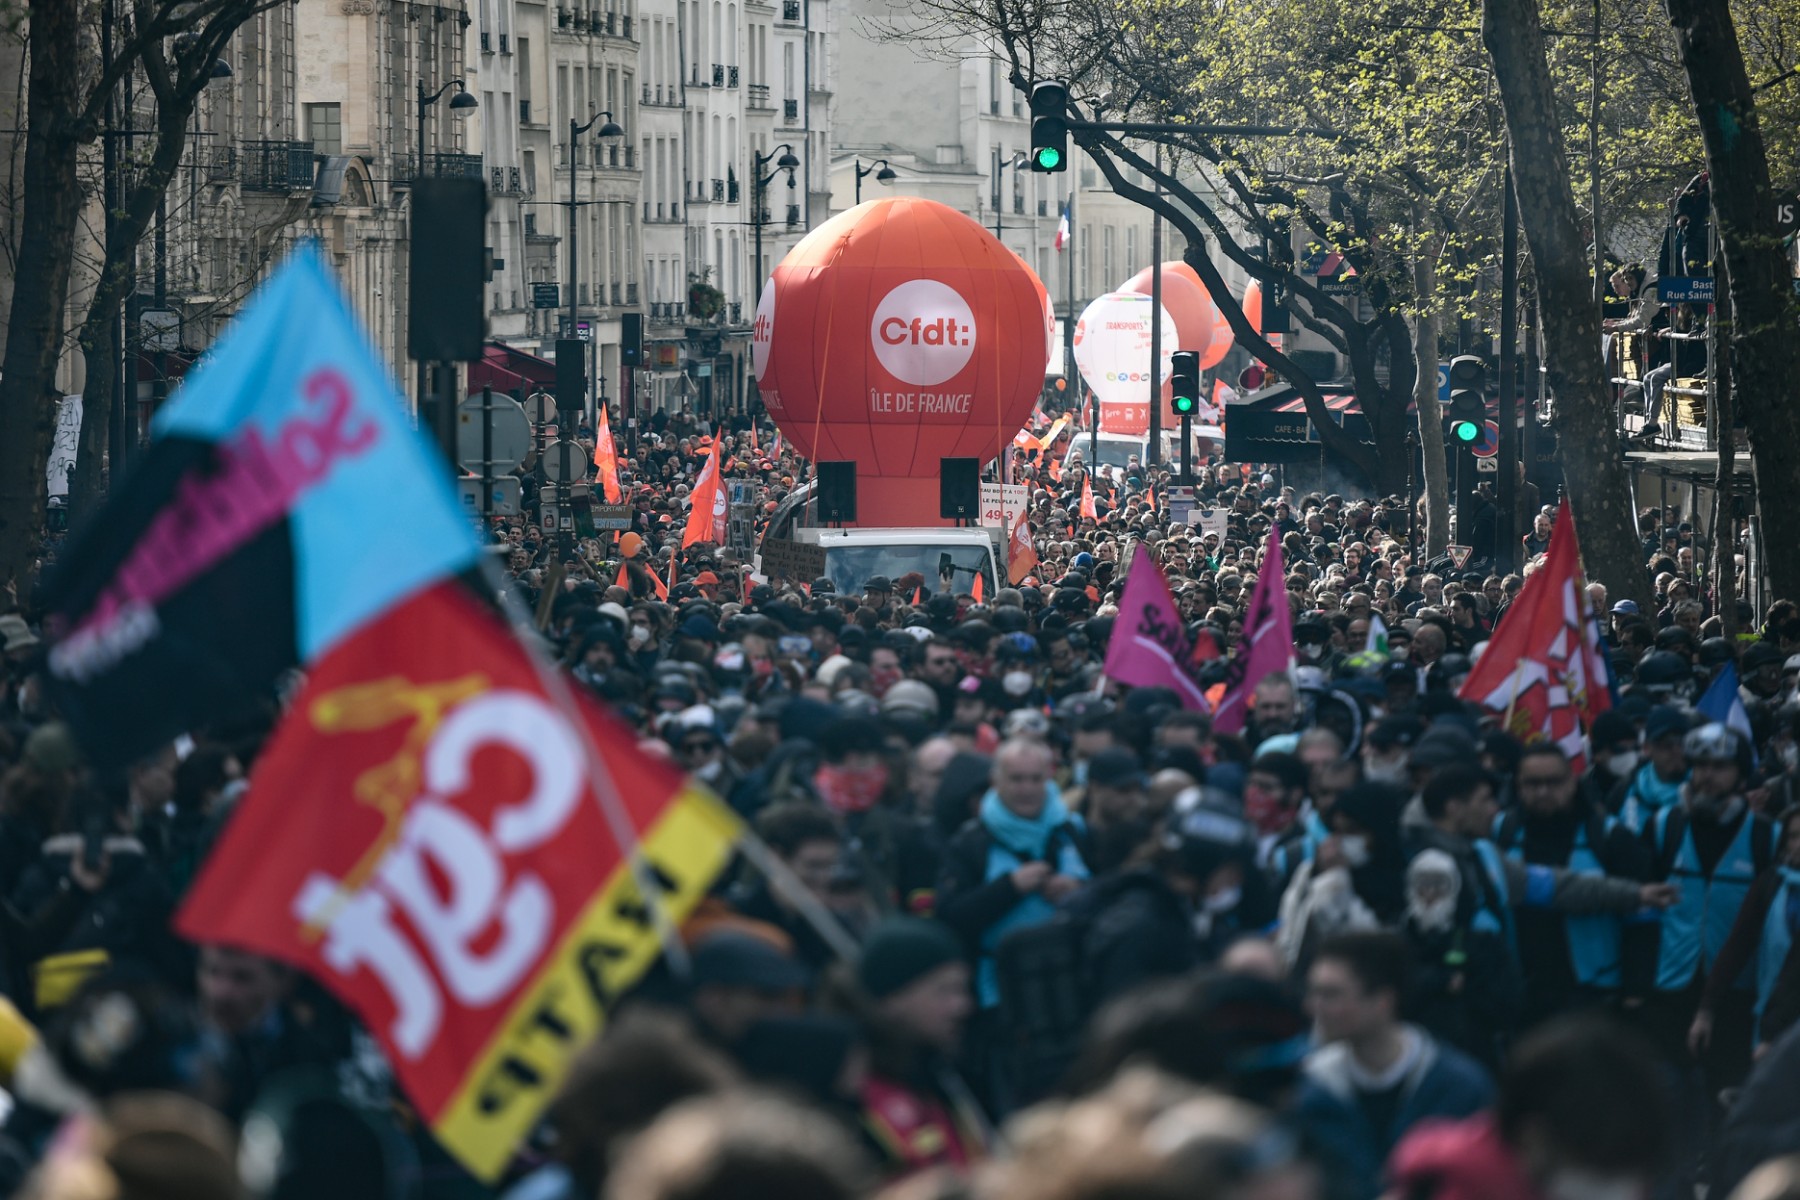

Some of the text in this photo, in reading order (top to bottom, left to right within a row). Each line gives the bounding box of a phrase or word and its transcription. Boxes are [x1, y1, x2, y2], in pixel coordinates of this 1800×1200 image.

[1666, 290, 1686, 300] Rue
[1105, 320, 1144, 331] TRANSPORTS
[870, 387, 972, 413] ÎLE DE FRANCE
[591, 505, 627, 513] IMPORTANT
